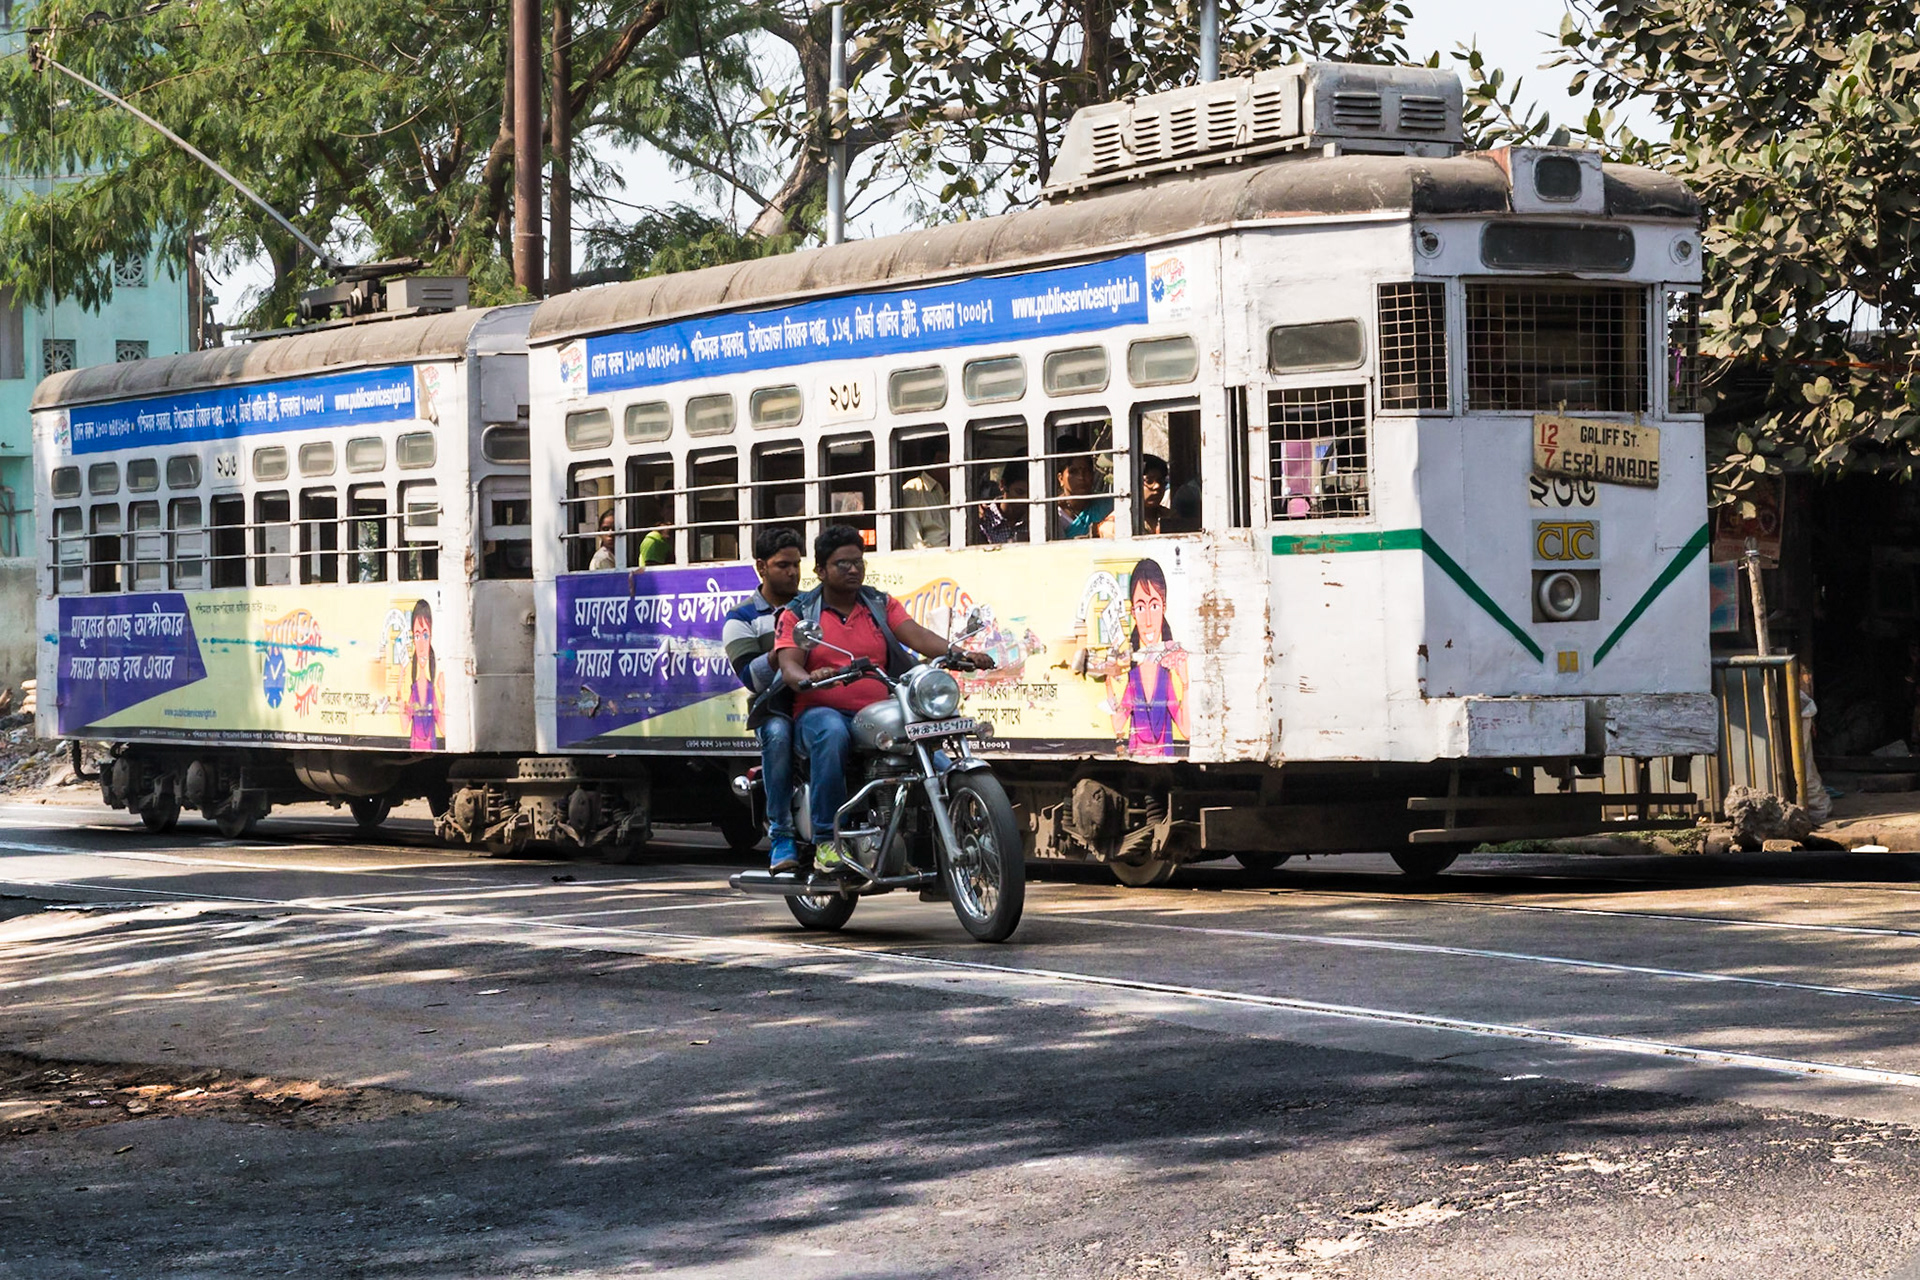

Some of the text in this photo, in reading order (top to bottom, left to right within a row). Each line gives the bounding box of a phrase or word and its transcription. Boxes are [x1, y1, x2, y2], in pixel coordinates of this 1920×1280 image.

[1011, 275, 1140, 323] www.publicservicesright.in
[334, 383, 411, 414] www.publicservicesright.in
[1540, 424, 1559, 445] 12
[1580, 425, 1640, 448] GALIFF ST.
[1544, 448, 1556, 468] 7
[1563, 452, 1659, 480] ESPLANADE
[1537, 521, 1595, 561] CTC
[575, 578, 756, 638] মানুষের কাছে অঙ্গীক
[71, 602, 185, 649] মানুষের কাছে অঙ্গীকার
[70, 655, 175, 682] সময়ে কাজ হবে এবার
[575, 649, 614, 678] সময়ে
[618, 648, 656, 677] কাজ
[660, 649, 687, 680] হবে
